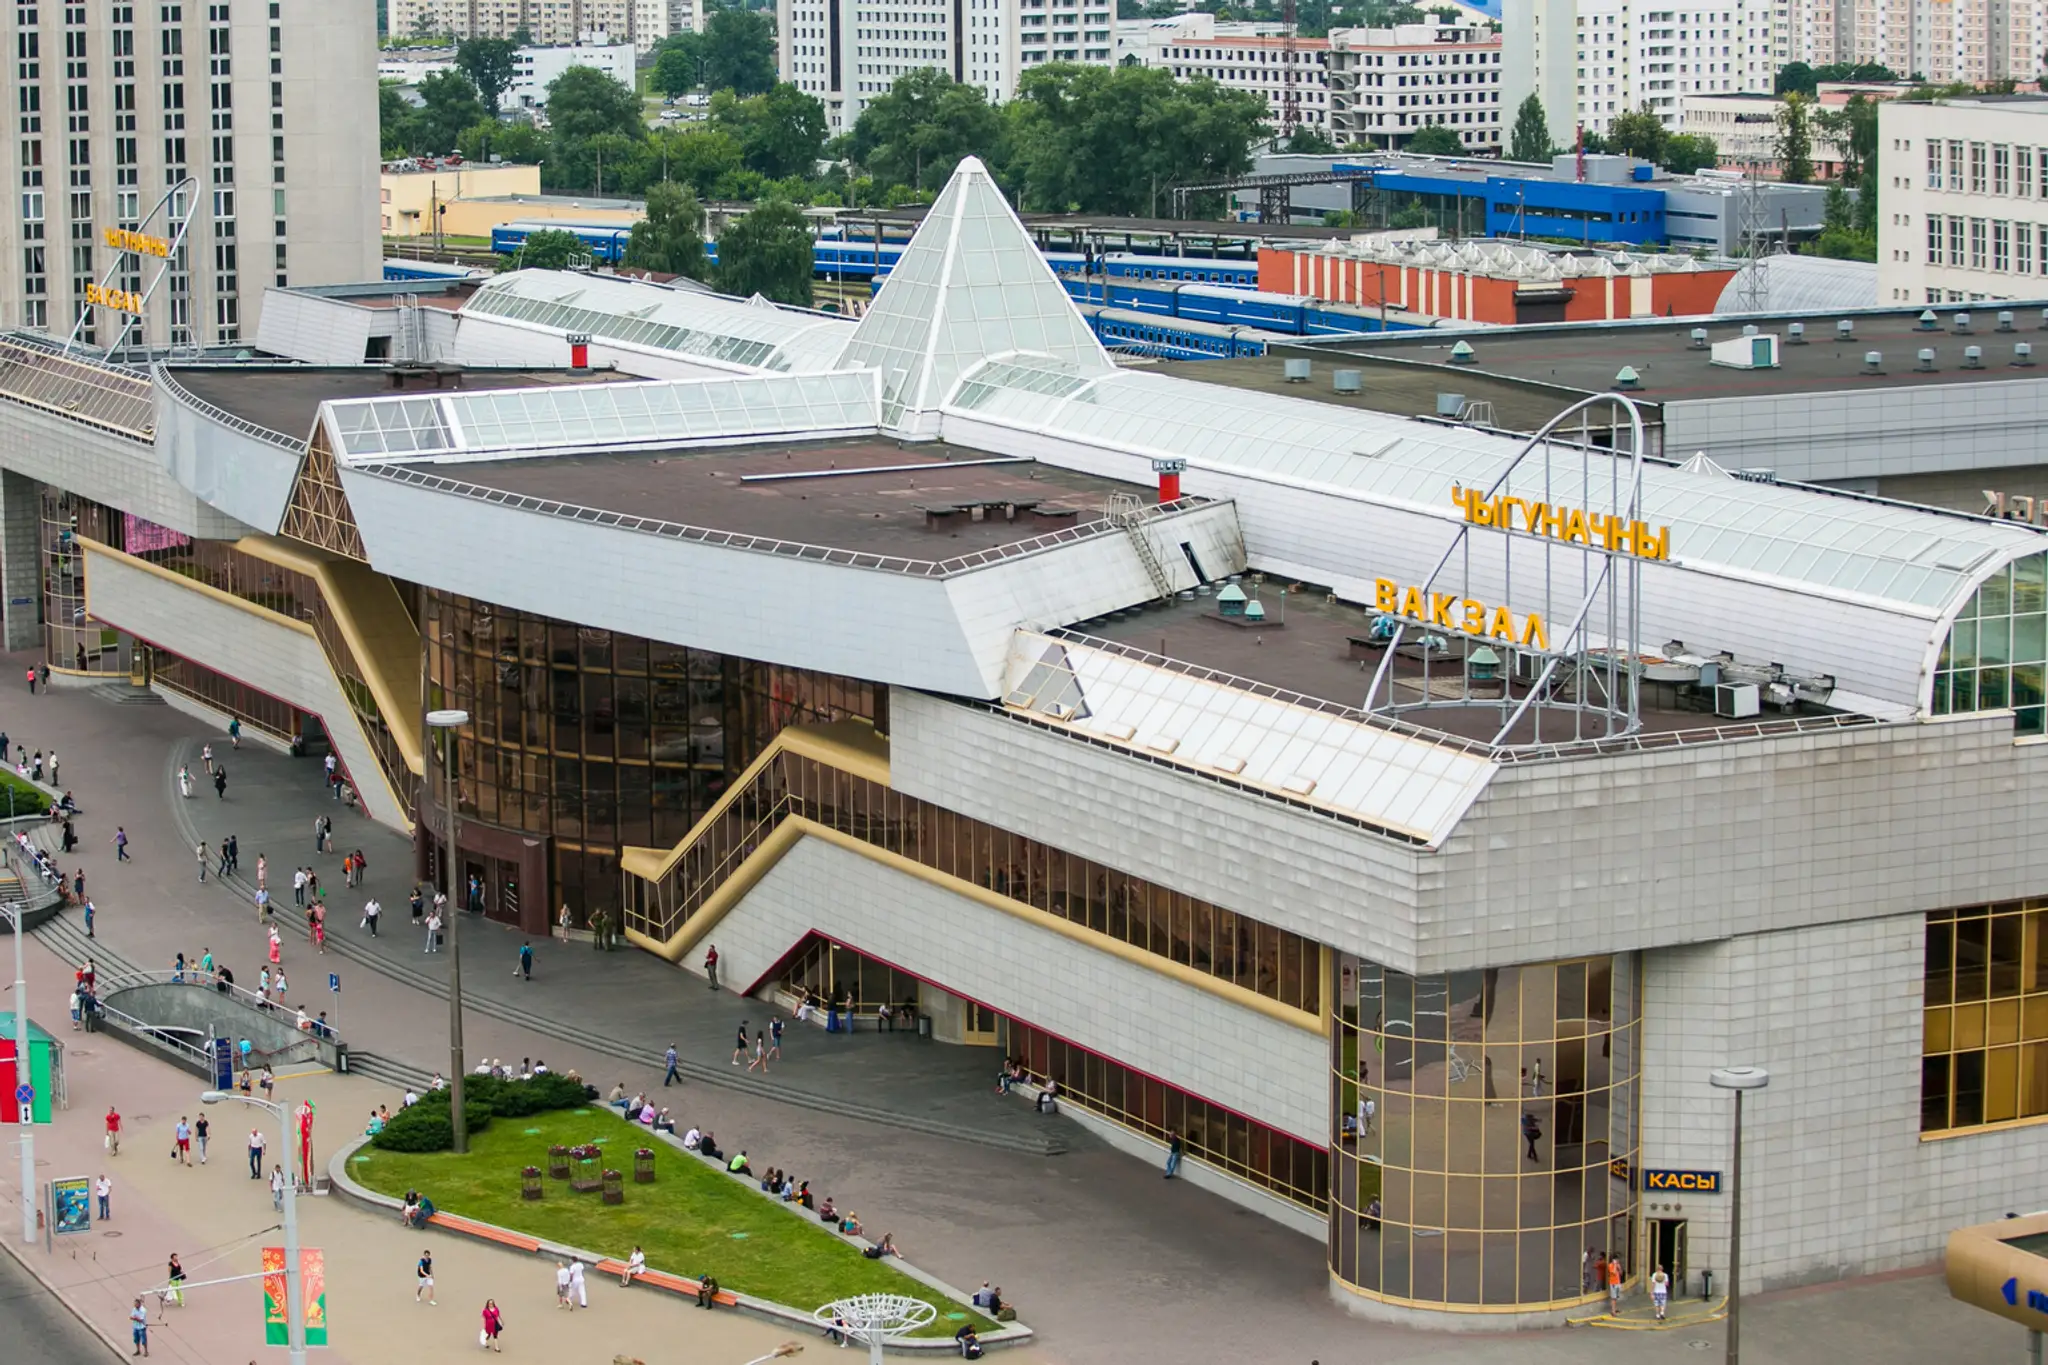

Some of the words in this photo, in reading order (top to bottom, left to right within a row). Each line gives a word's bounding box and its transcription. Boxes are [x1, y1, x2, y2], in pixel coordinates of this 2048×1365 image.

[87, 283, 143, 314] ВАКЗАЛ
[1452, 486, 1670, 560] ЧЫГУНАЧНЫ
[1375, 577, 1550, 649] ВАКЗАЛ
[1649, 1173, 1715, 1189] КАСЫ
